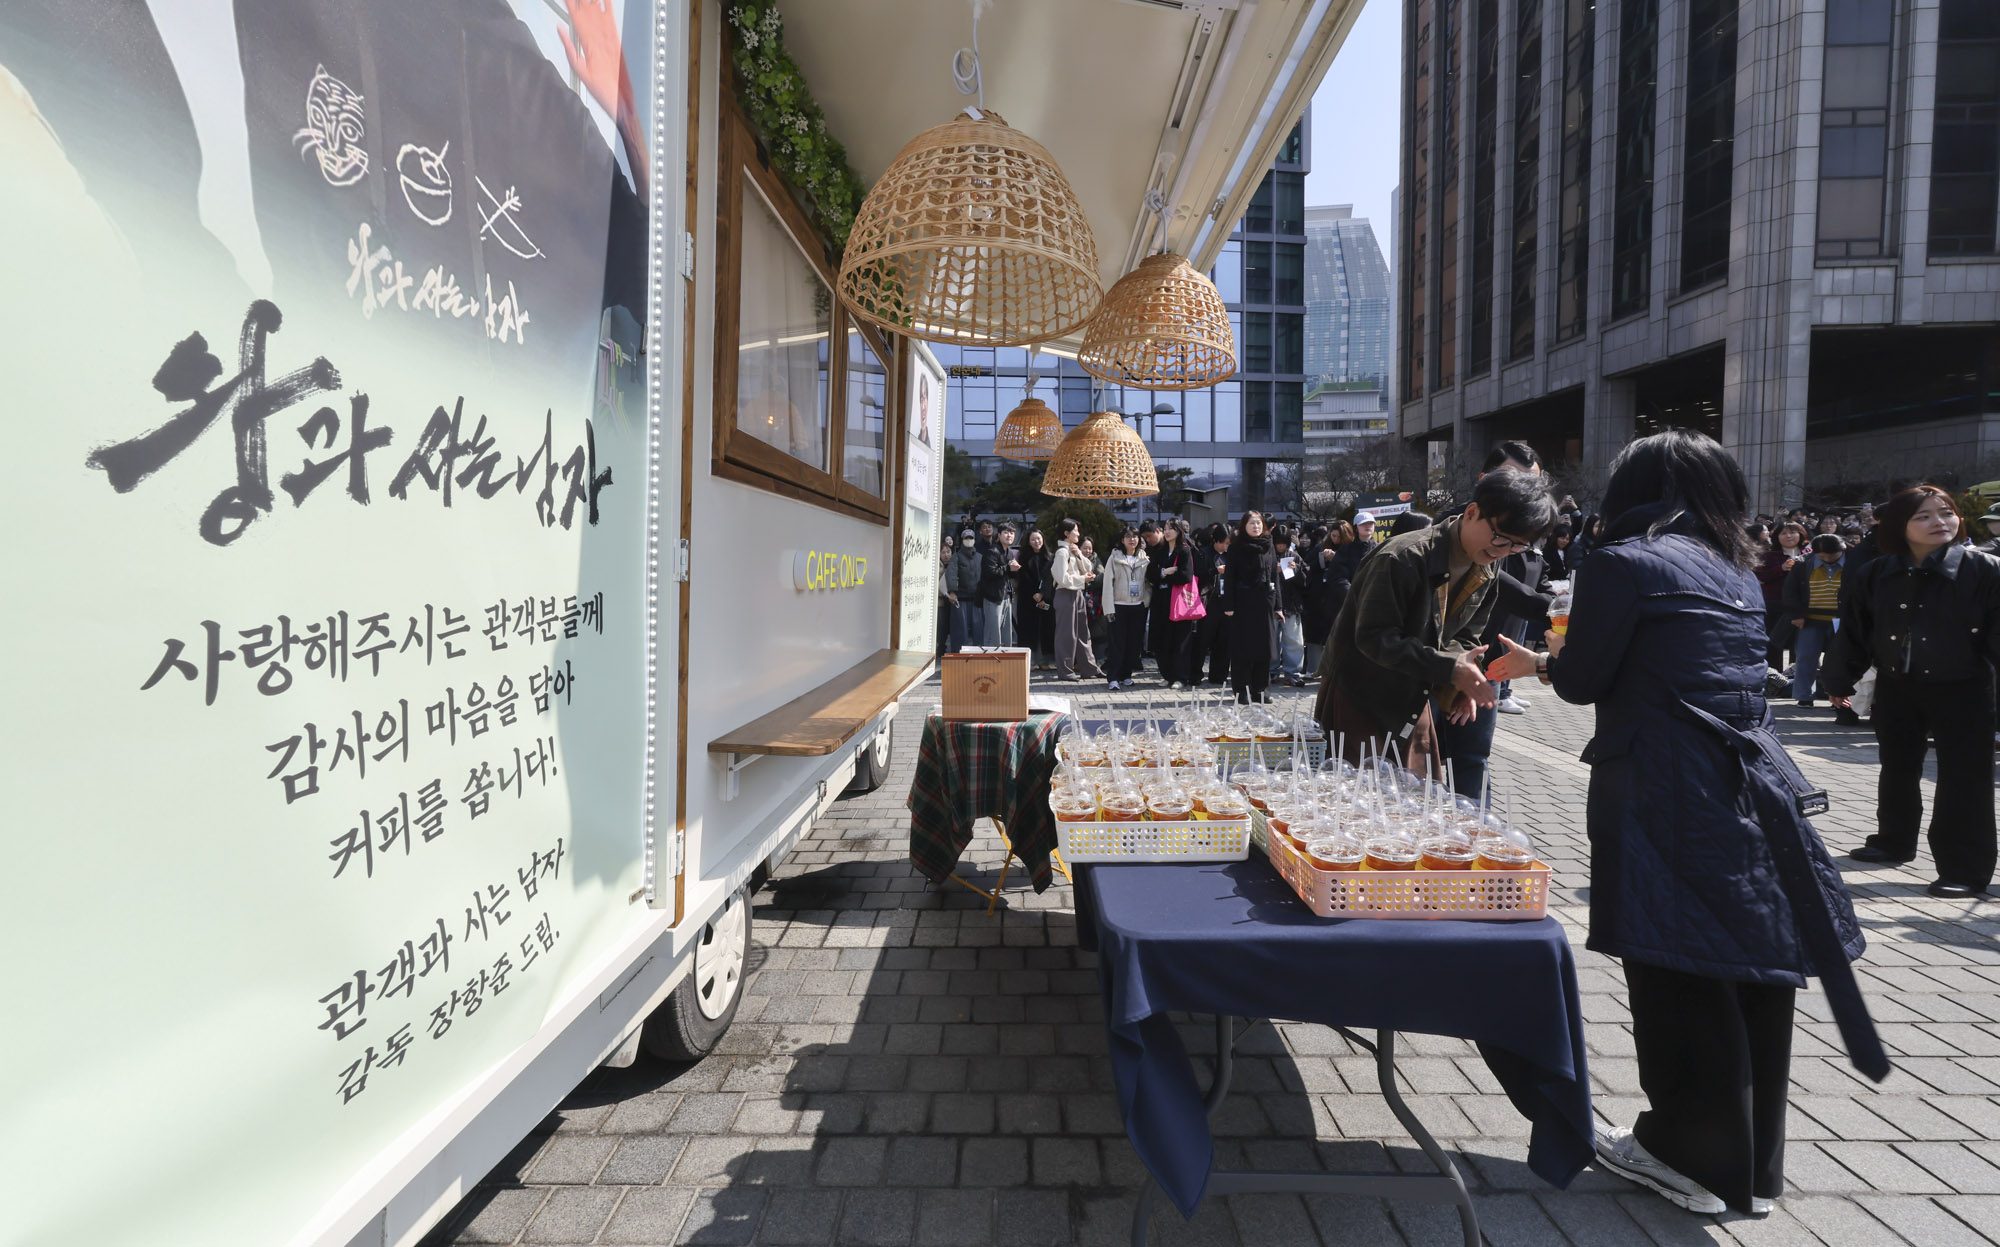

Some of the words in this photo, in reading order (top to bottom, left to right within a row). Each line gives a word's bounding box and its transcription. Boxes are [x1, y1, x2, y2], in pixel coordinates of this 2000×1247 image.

[346, 222, 413, 320] 왕과
[85, 299, 395, 547] 왕과
[515, 407, 614, 531] 남자
[140, 603, 471, 706] 사랑해주시는
[482, 591, 603, 651] 관객분들께
[265, 698, 409, 804] 감사의
[425, 674, 519, 746] 마음을
[528, 659, 575, 716] 담아
[328, 778, 448, 879] 커피를
[460, 735, 558, 820] 쏩니다!
[317, 918, 453, 1041] 관객과
[464, 883, 512, 942] 사는
[517, 837, 565, 902] 남자
[335, 1022, 415, 1105] 감독
[426, 951, 513, 1040] 장항준
[519, 912, 560, 972] 드림.
